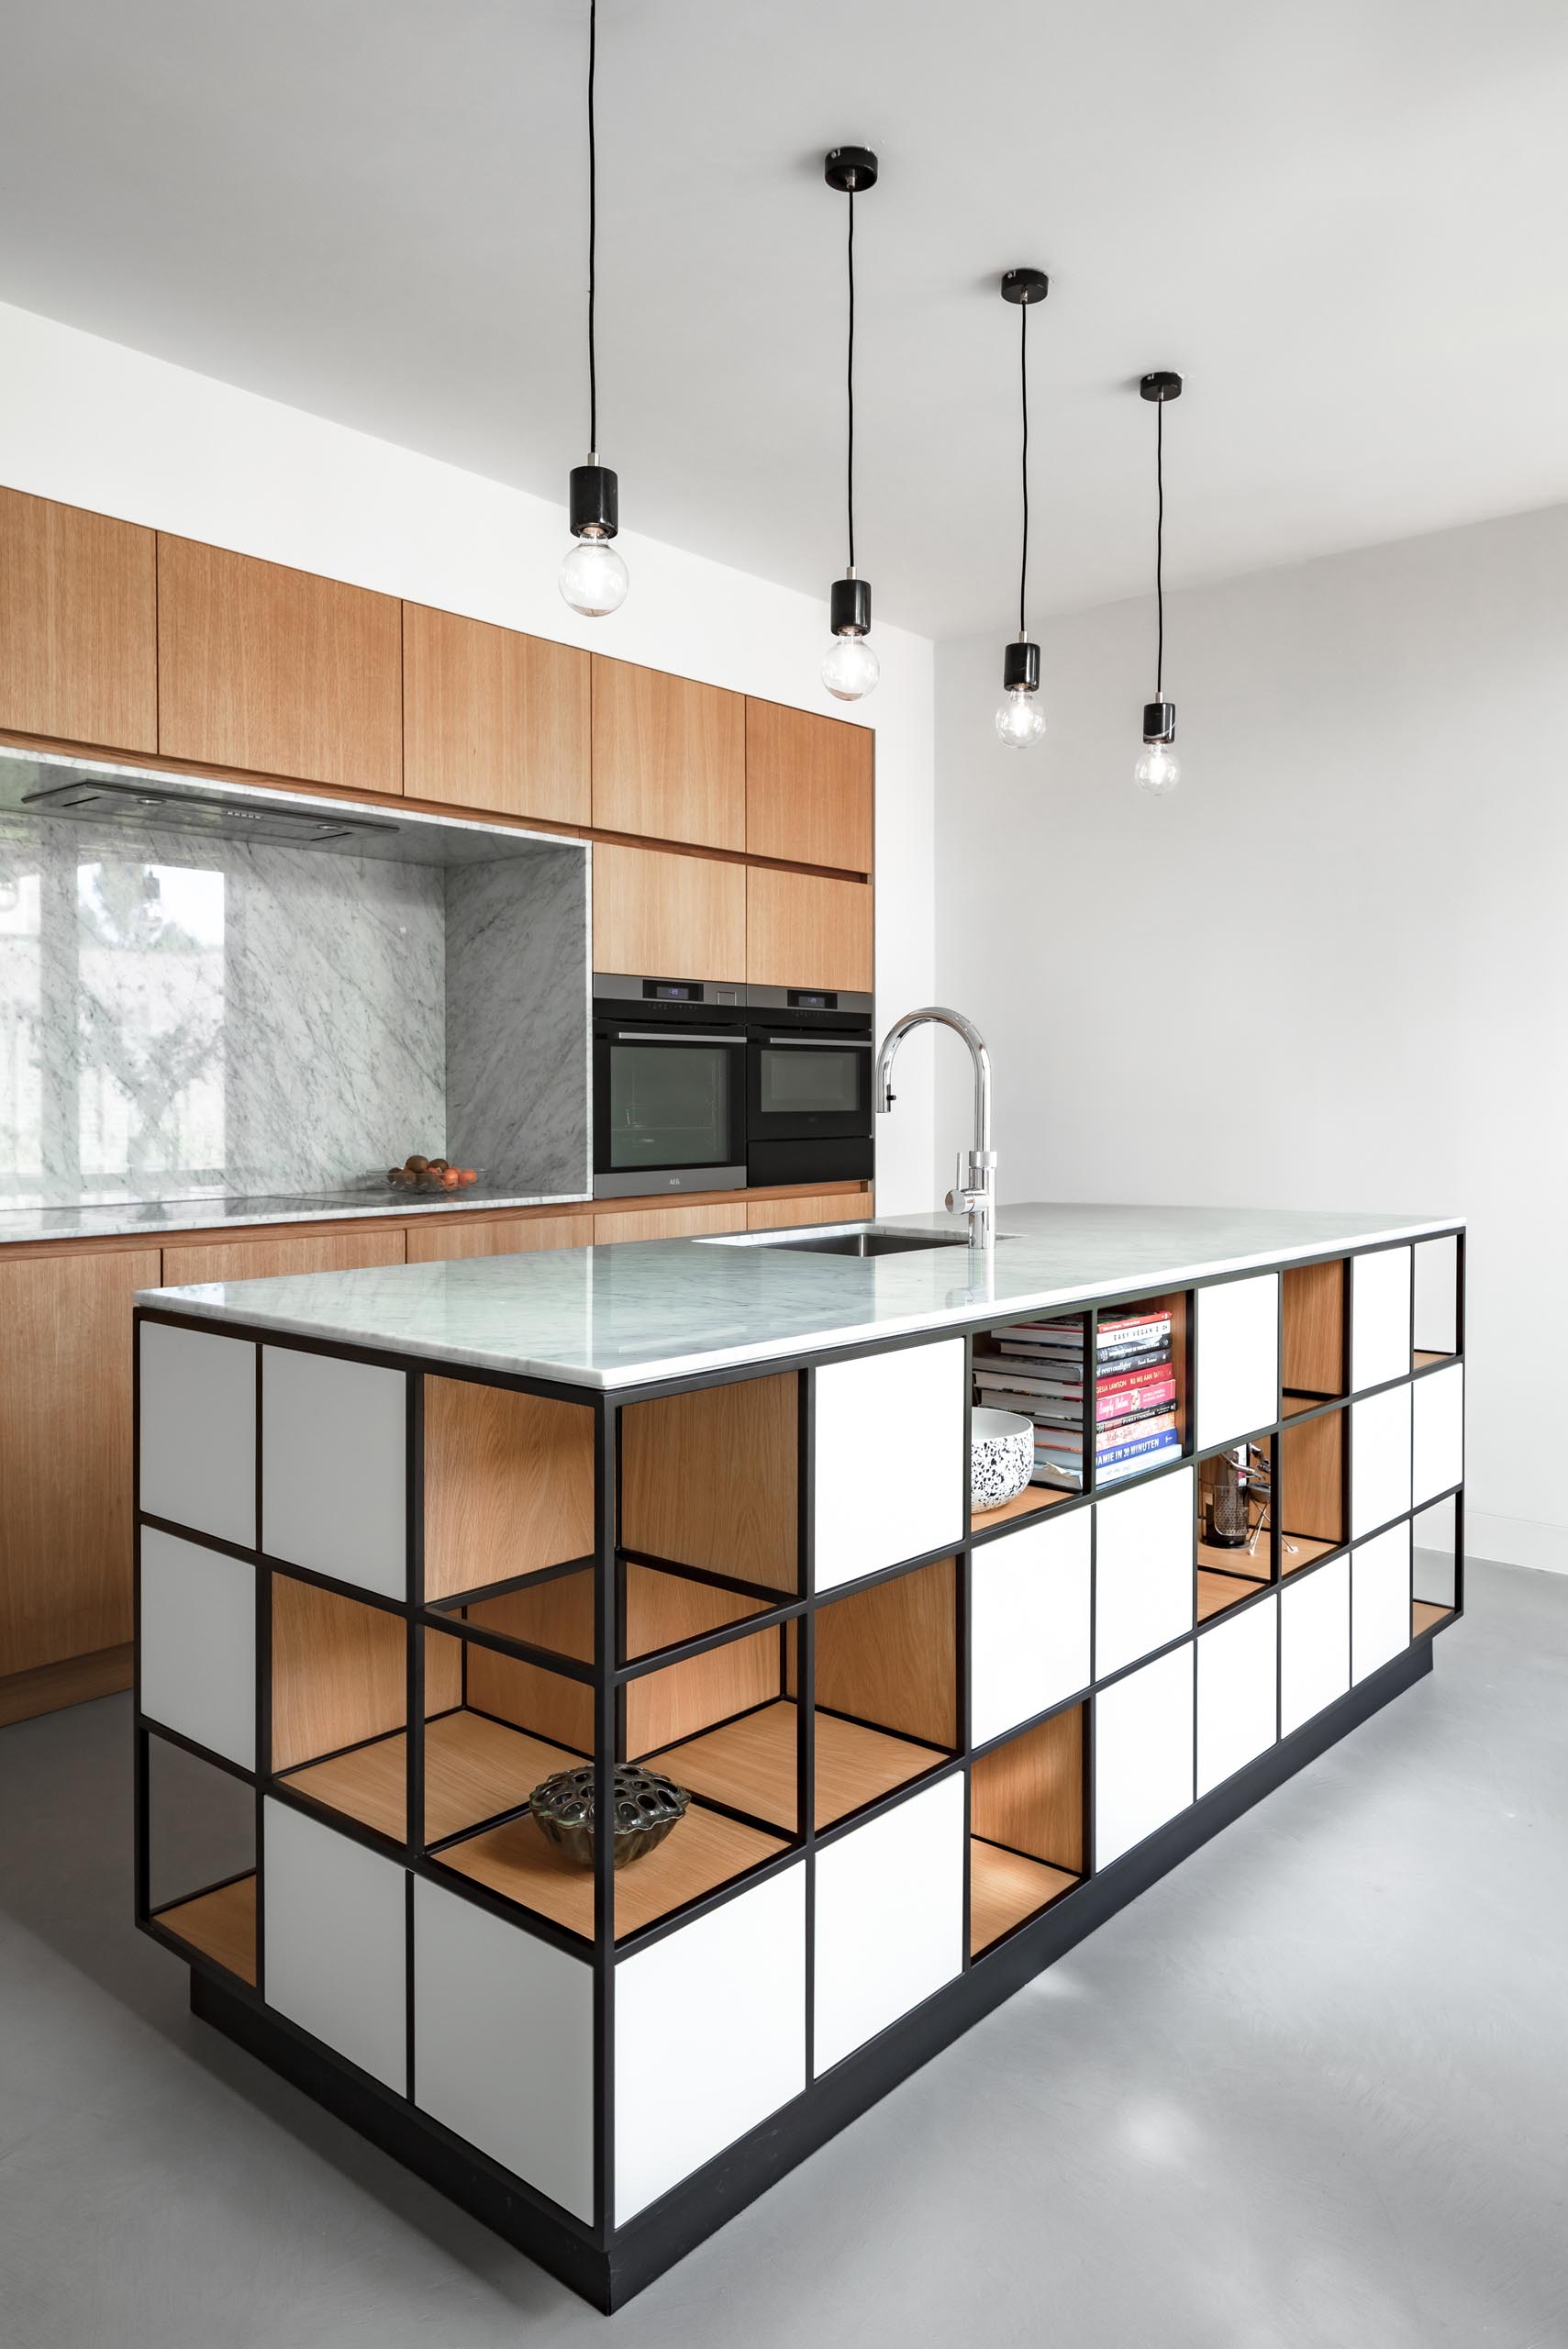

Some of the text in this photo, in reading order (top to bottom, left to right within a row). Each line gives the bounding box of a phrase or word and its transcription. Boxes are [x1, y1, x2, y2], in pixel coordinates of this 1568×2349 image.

[1114, 1332, 1129, 1341] EASY
[1132, 1328, 1152, 1336] VEGAN
[1109, 1380, 1127, 1390] LAWSON
[1115, 1449, 1122, 1460] IN
[1123, 1447, 1129, 1457] 30
[1130, 1438, 1160, 1454] MINUTEN
